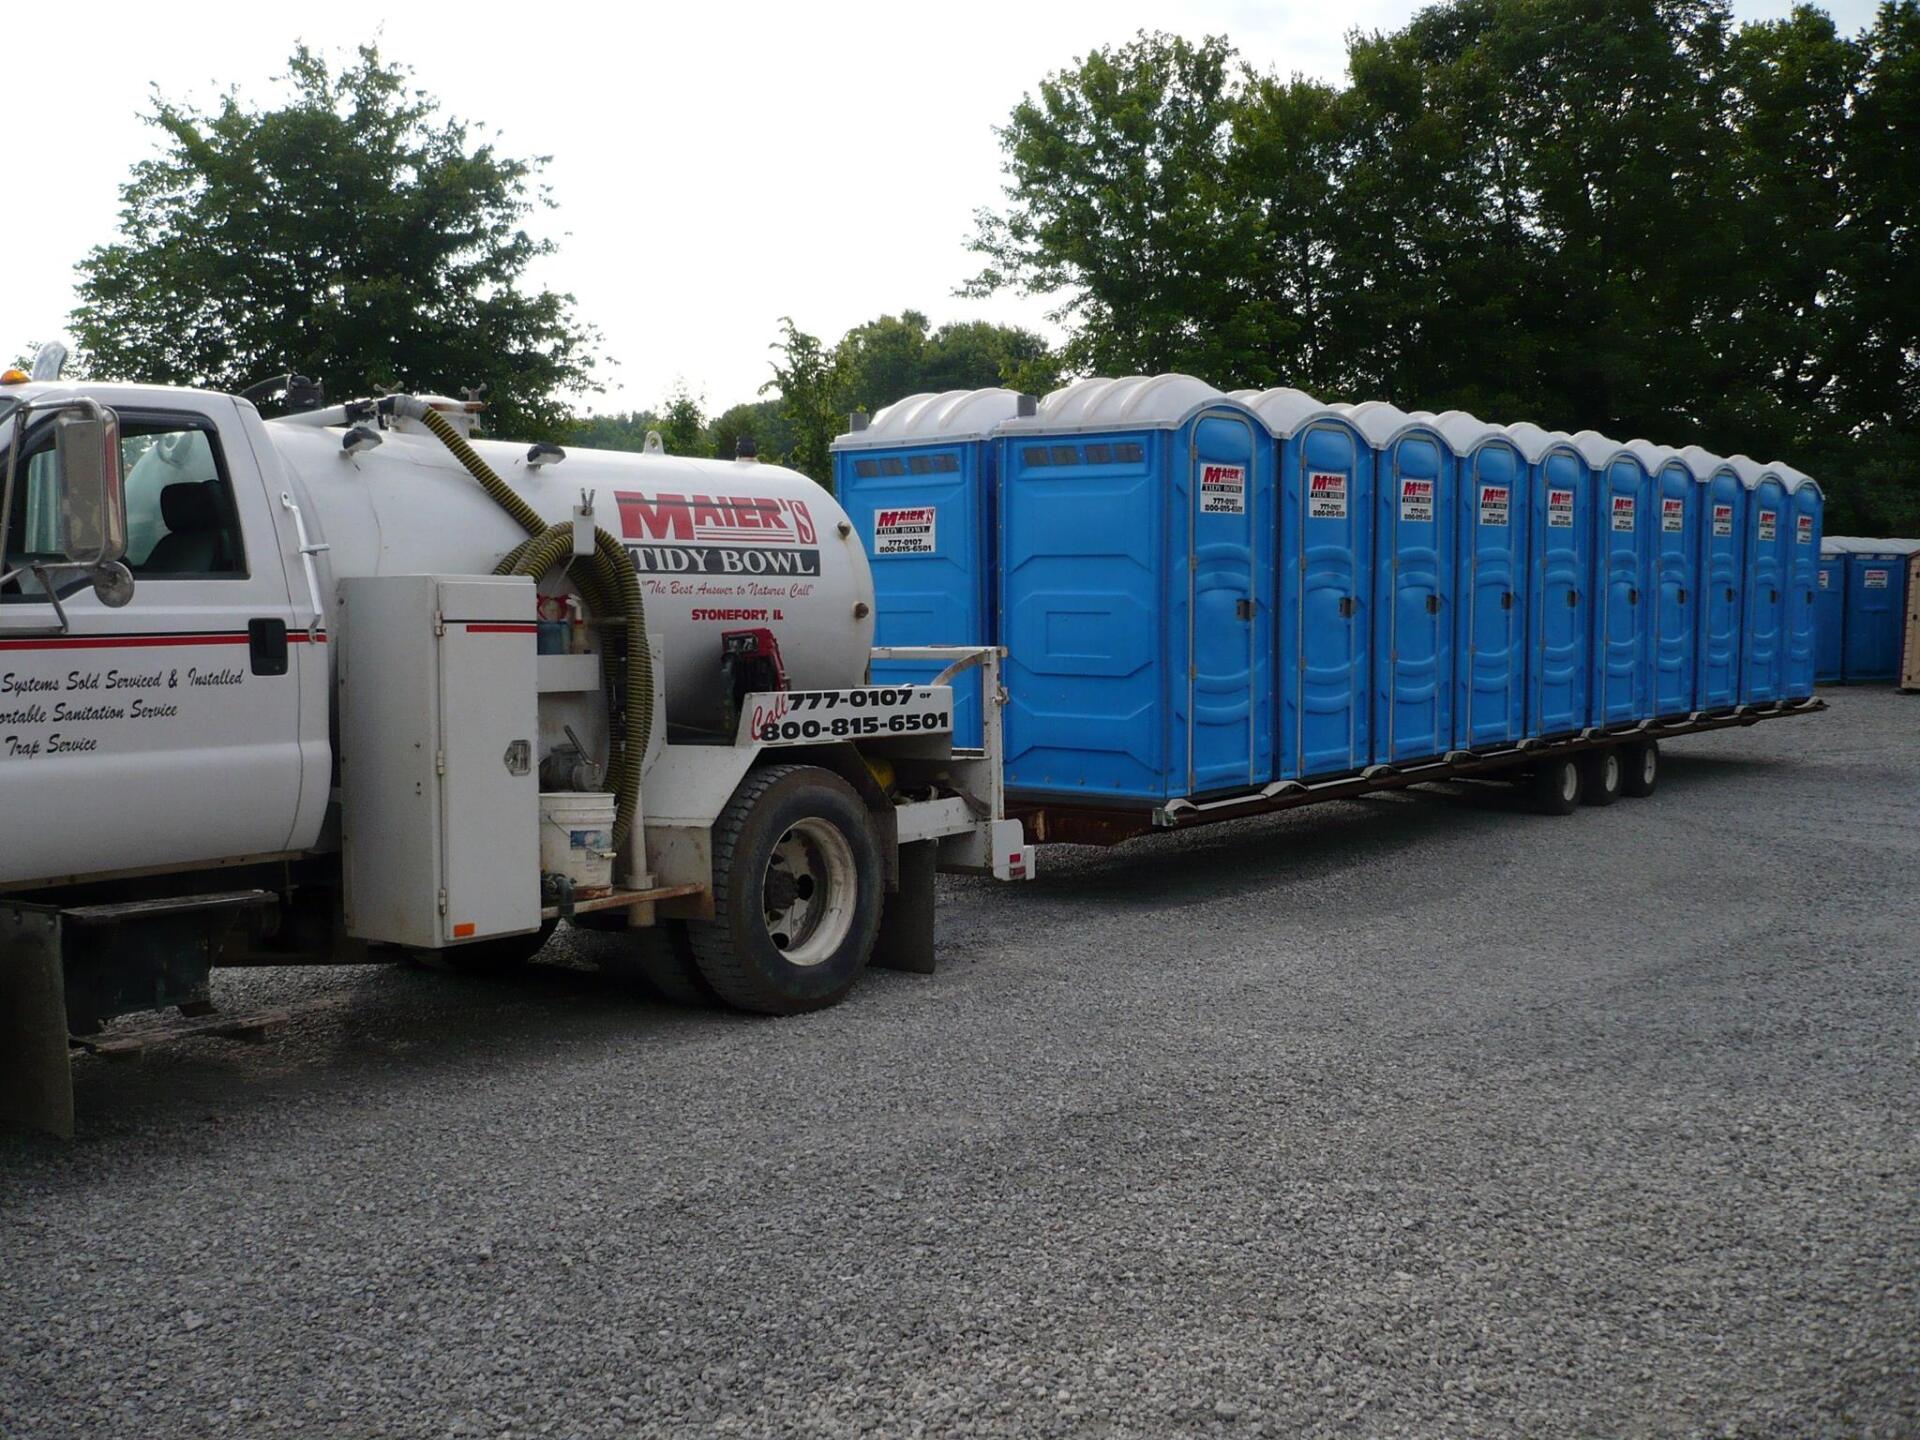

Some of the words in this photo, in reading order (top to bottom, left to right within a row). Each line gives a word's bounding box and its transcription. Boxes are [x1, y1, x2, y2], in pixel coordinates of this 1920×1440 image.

[614, 491, 817, 545] MAIER'S
[878, 509, 934, 526] MAIER'S
[628, 546, 709, 572] TIDY
[719, 549, 815, 575] BOWL
[879, 545, 932, 553] 800-815-6501
[669, 580, 693, 596] Best
[695, 581, 733, 596] Answer
[737, 584, 746, 596] to
[748, 581, 786, 597] Natures
[691, 608, 769, 623] STONEFORT,
[773, 608, 784, 621] IL
[1, 672, 59, 697] Systems
[66, 671, 100, 690] Sold
[105, 669, 162, 689] Serviced
[168, 668, 178, 688] &
[188, 667, 244, 686] Installed
[0, 704, 47, 724] ortable
[53, 702, 125, 722] Sanitation
[130, 699, 178, 718] Service
[788, 689, 913, 711] 777-0107
[752, 692, 789, 741] Call
[760, 712, 948, 741] 800-815-6501
[5, 735, 40, 758] Trap
[46, 733, 97, 753] Service
